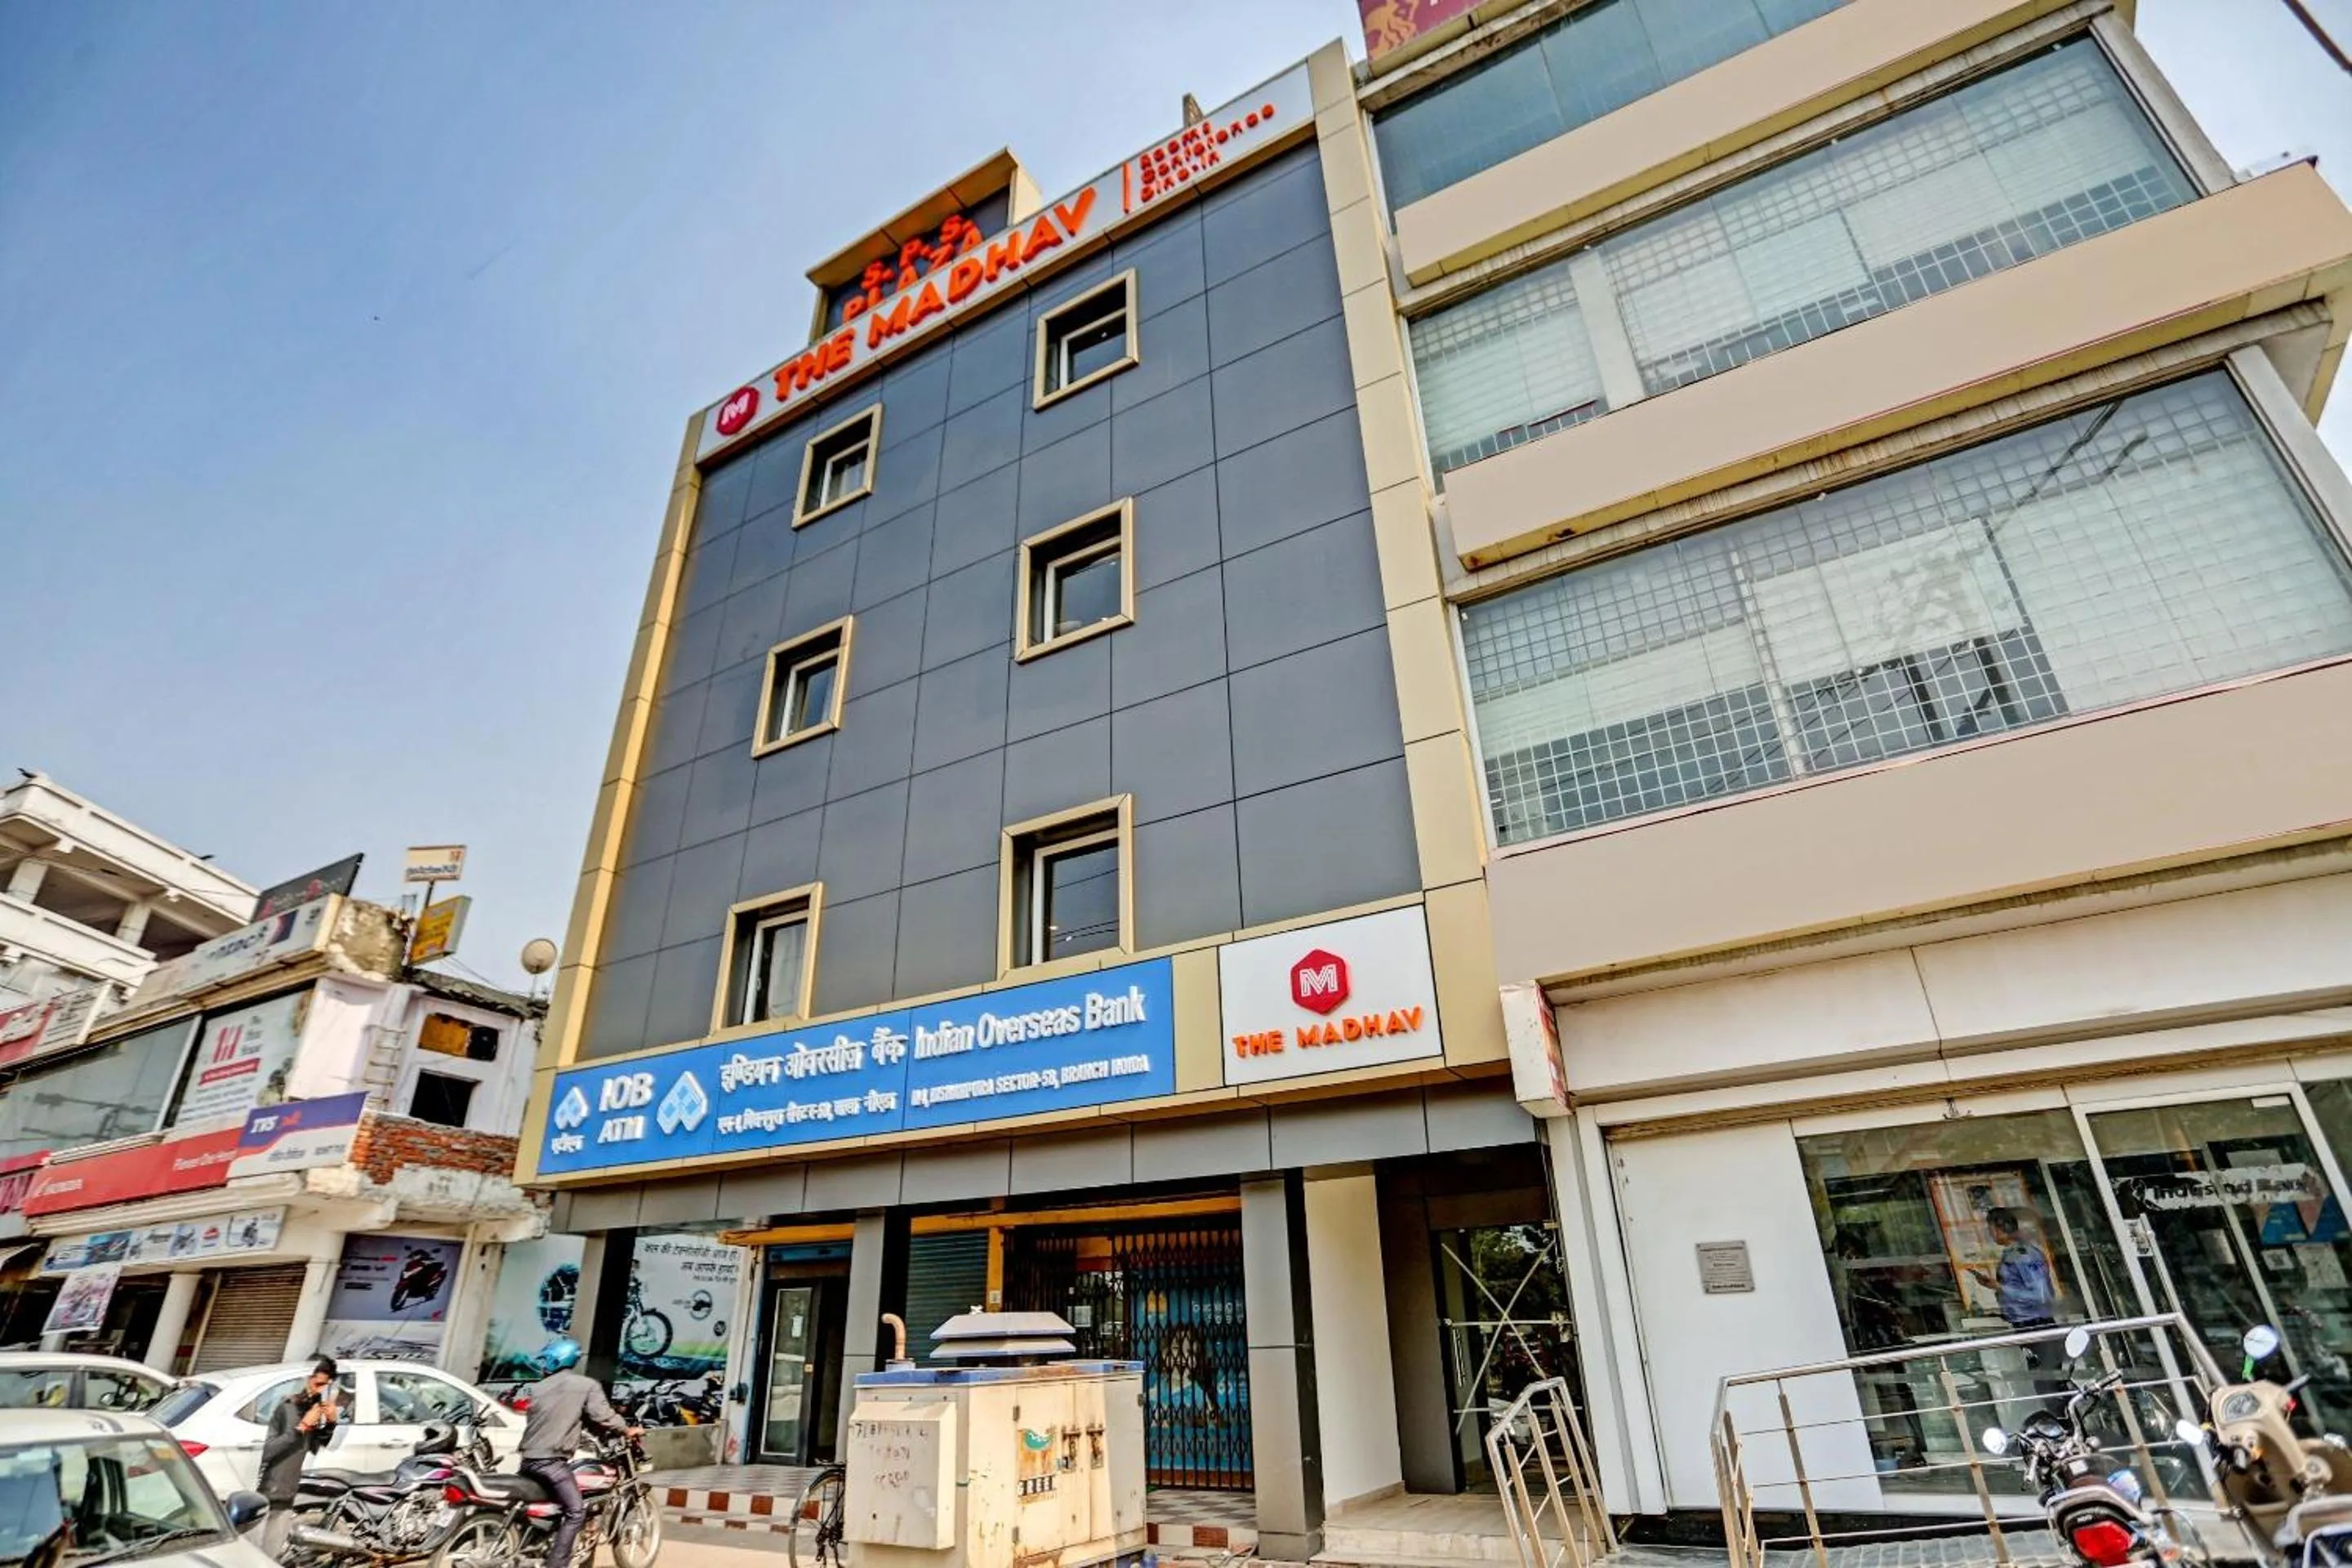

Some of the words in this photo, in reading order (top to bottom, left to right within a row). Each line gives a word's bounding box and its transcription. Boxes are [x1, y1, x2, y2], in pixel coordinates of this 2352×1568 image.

[773, 327, 855, 402] THE
[866, 186, 1097, 350] MADHAV
[1299, 964, 1339, 997] M
[914, 1021, 975, 1059] Indian
[977, 1004, 1081, 1049] Overseas
[1085, 985, 1147, 1031] Bank
[1232, 1030, 1285, 1058] THE
[1295, 1004, 1423, 1049] MADHAV
[871, 1027, 908, 1065] बैंक
[1061, 1059, 1109, 1084] BRANCH
[599, 1072, 654, 1112] IOB
[250, 1115, 279, 1134] TVS
[598, 1116, 645, 1143] ATM
